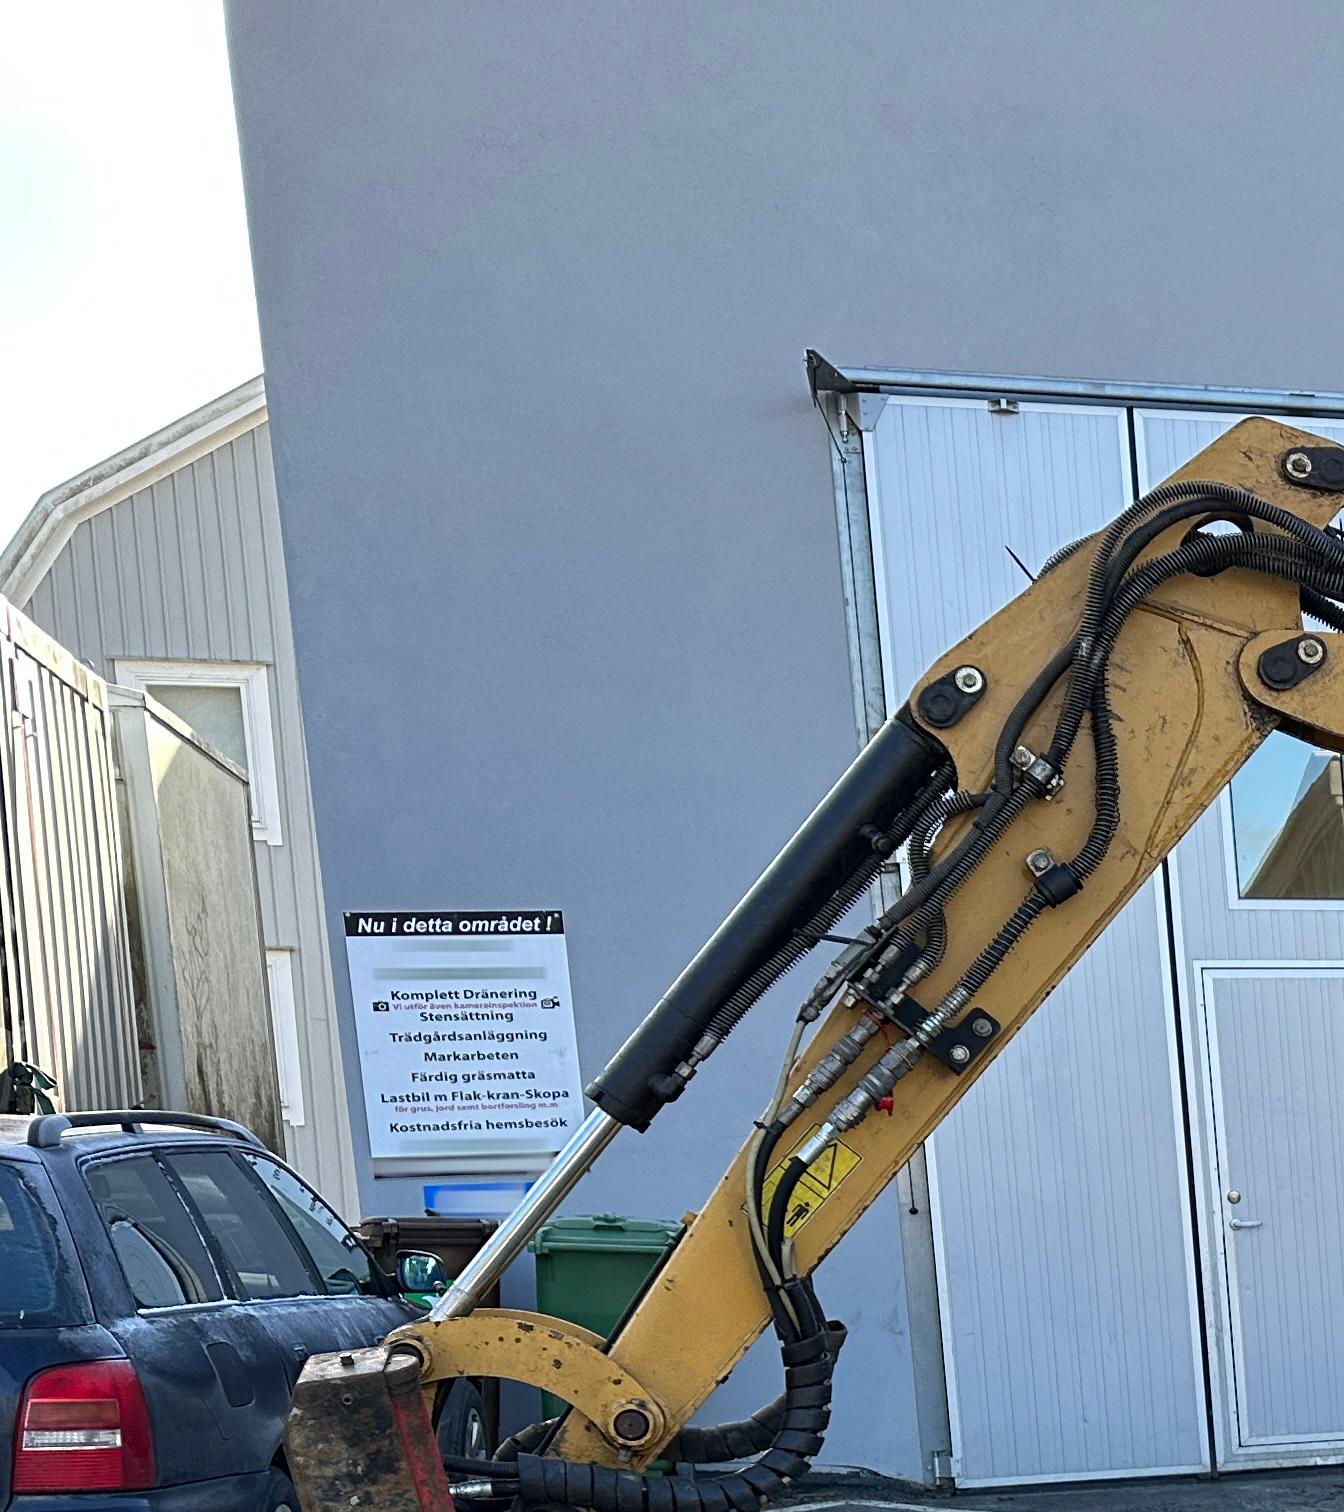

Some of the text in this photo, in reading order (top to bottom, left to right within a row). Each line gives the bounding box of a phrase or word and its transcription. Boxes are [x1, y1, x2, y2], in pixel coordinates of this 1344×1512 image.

[357, 917, 385, 933] Nu
[391, 917, 398, 933] i
[403, 917, 453, 933] detta
[458, 915, 541, 932] området
[391, 988, 537, 1003] Komplett Dränering
[419, 1010, 514, 1023] Stensättning
[389, 1030, 548, 1044] Trädgårdsanläggning
[424, 1051, 519, 1062] Markarbeten
[411, 1070, 536, 1084] Färdig gräsmatta
[380, 1089, 570, 1104] Lastbil m Flak-kran-Skopa
[389, 1118, 569, 1133] Kostnadsfria hemsbesök
